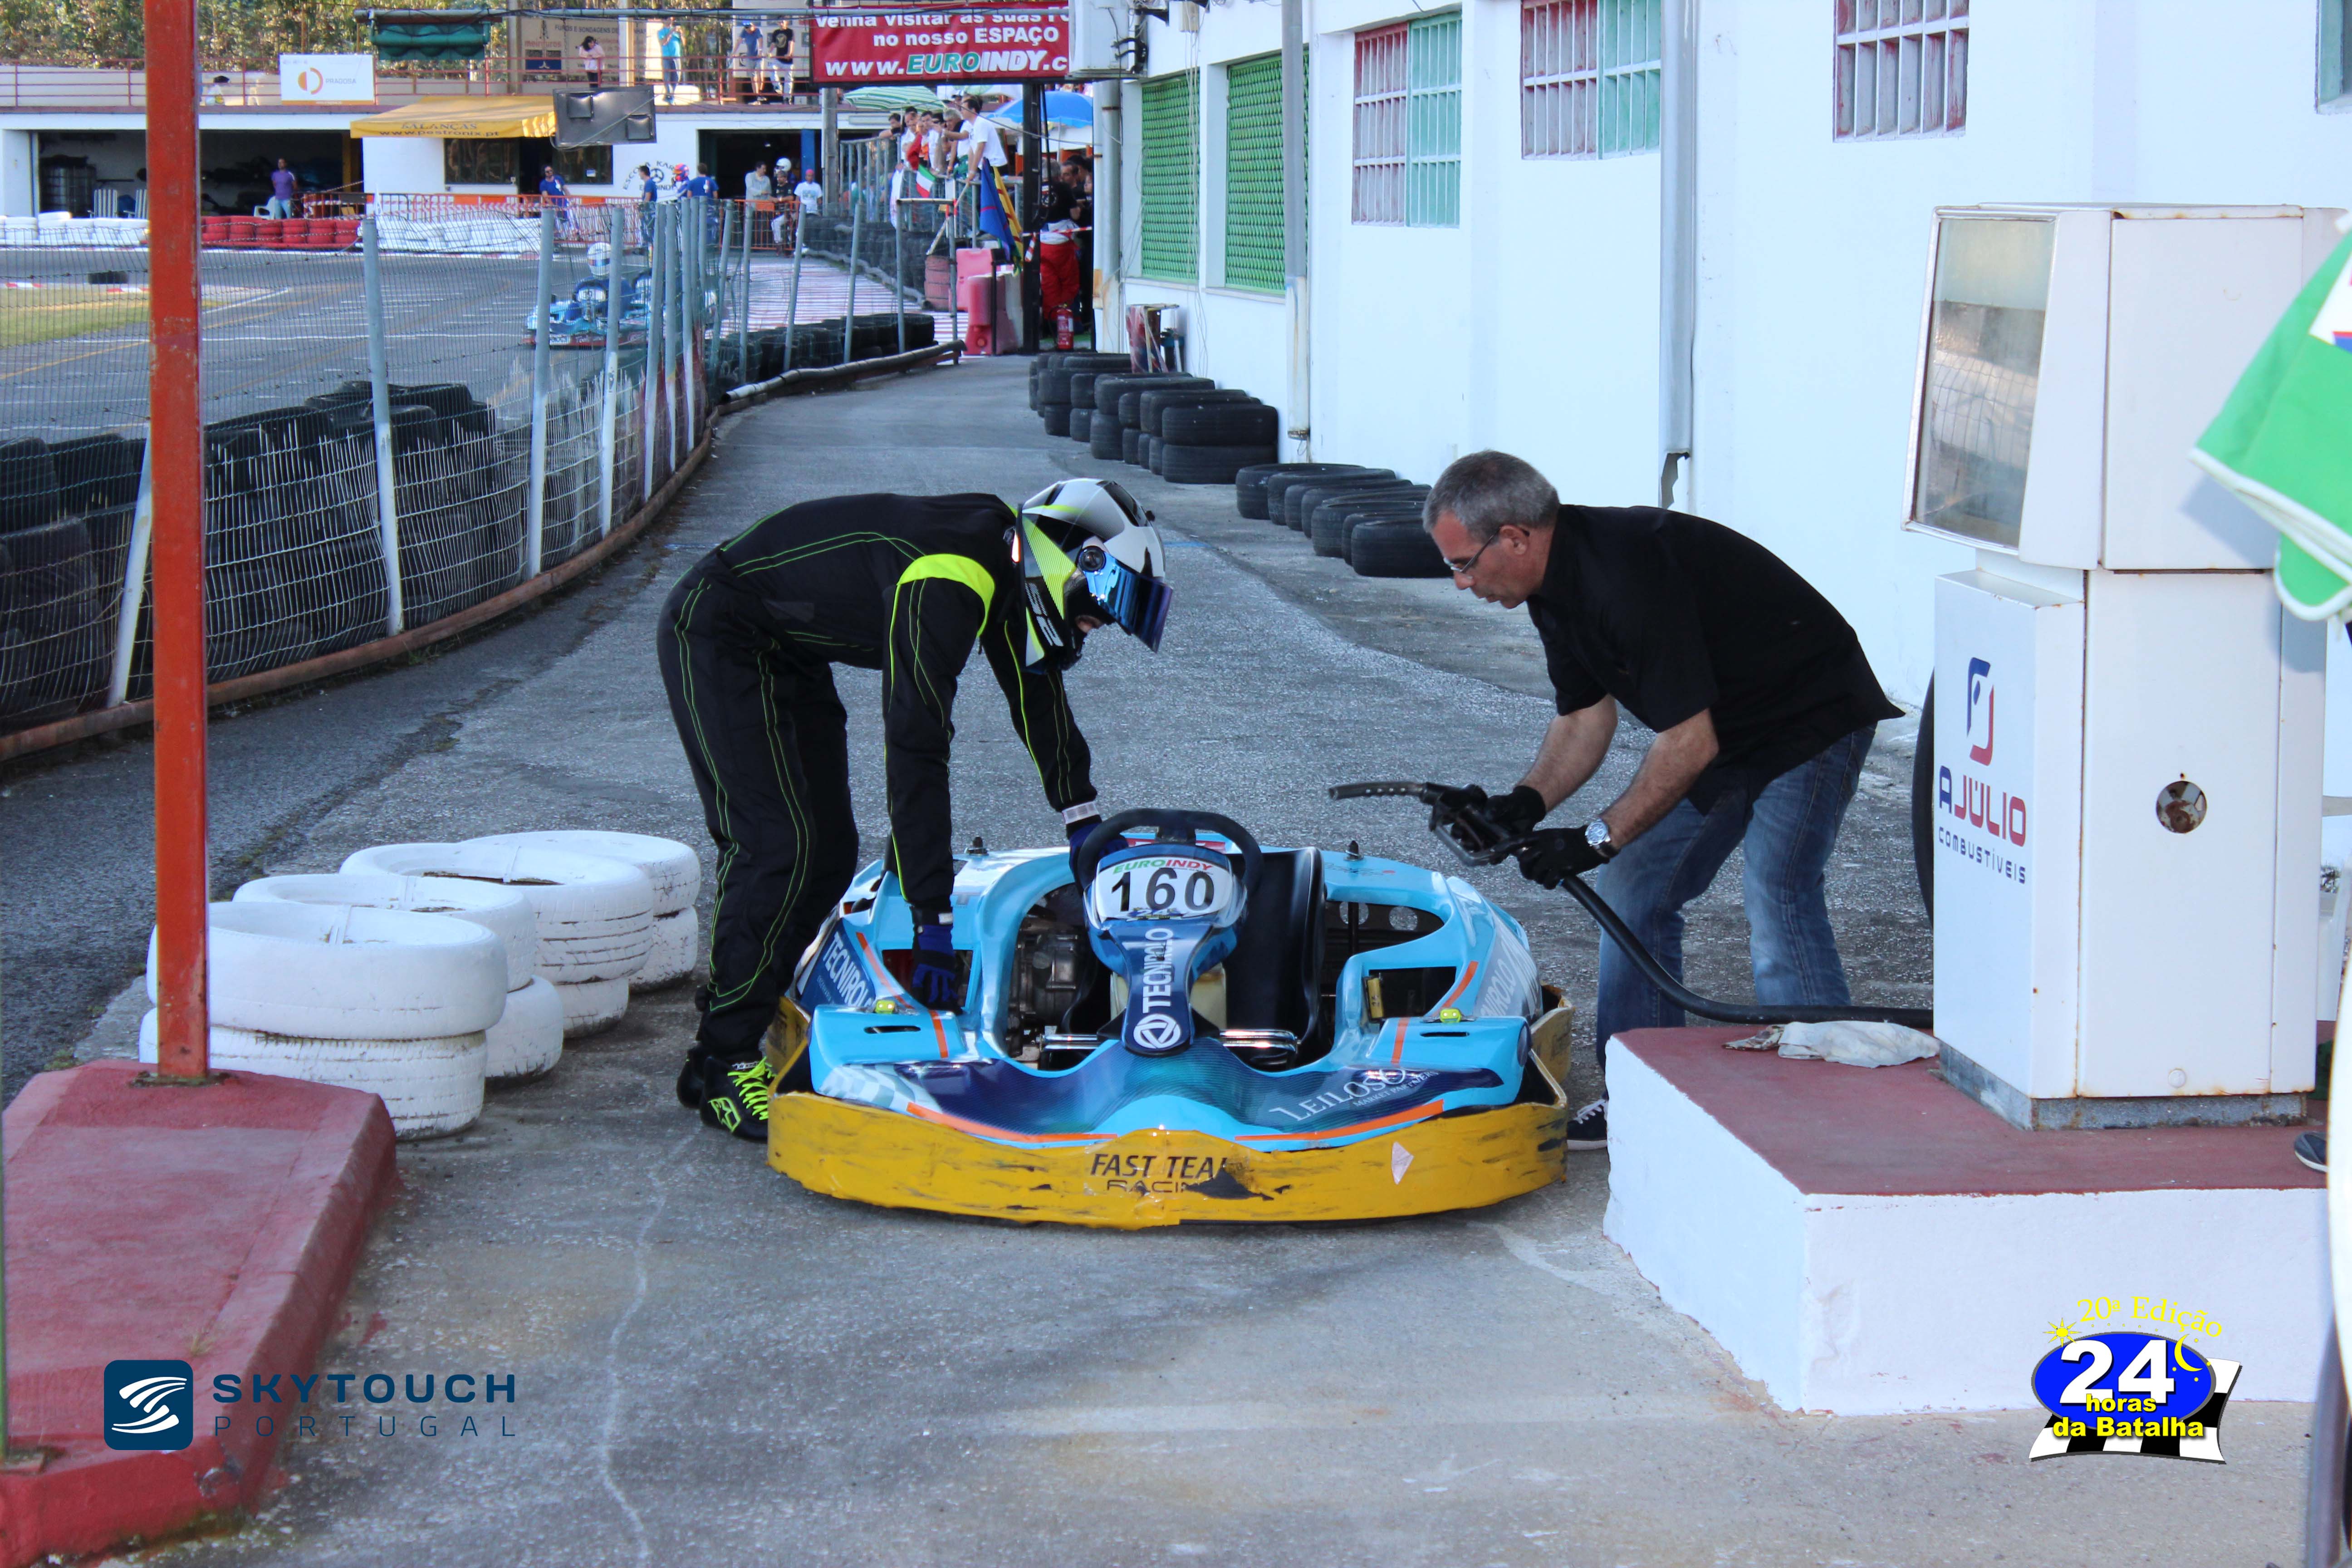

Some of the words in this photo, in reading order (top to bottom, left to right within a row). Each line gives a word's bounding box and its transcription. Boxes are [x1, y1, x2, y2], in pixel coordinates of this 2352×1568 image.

[885, 15, 952, 26] visitar
[960, 14, 984, 23] as
[992, 14, 1041, 23] suas
[873, 34, 899, 46] no
[905, 32, 968, 46] nosso
[975, 26, 1059, 46] ESPAÇO
[656, 161, 675, 172] KAR
[1112, 859, 1214, 874] EUROINDY
[1939, 827, 2025, 884] COMBUSTÍVEIS
[1111, 867, 1215, 912] 160
[1142, 928, 1174, 1014] TECNIROLO
[1090, 1153, 1156, 1178] FAST
